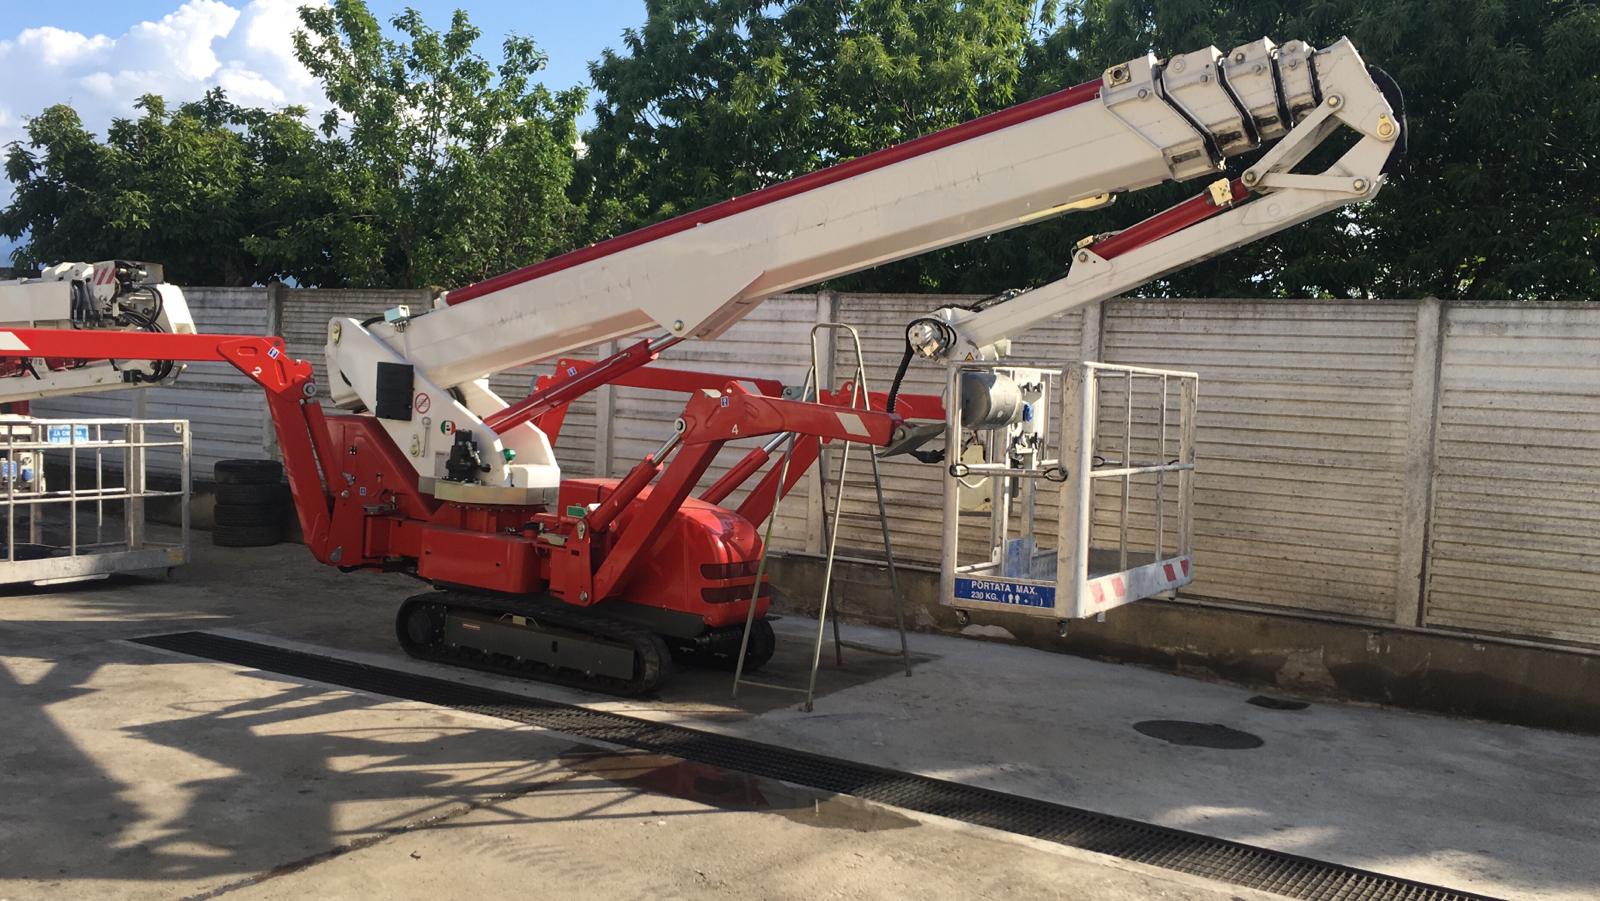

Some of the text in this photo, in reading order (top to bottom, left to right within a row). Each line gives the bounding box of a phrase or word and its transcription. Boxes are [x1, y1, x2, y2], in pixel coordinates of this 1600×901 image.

[251, 366, 262, 377] 2
[732, 424, 738, 435] 4
[971, 580, 1038, 595] PORTATA MAX.
[971, 591, 998, 601] 230 KG.
